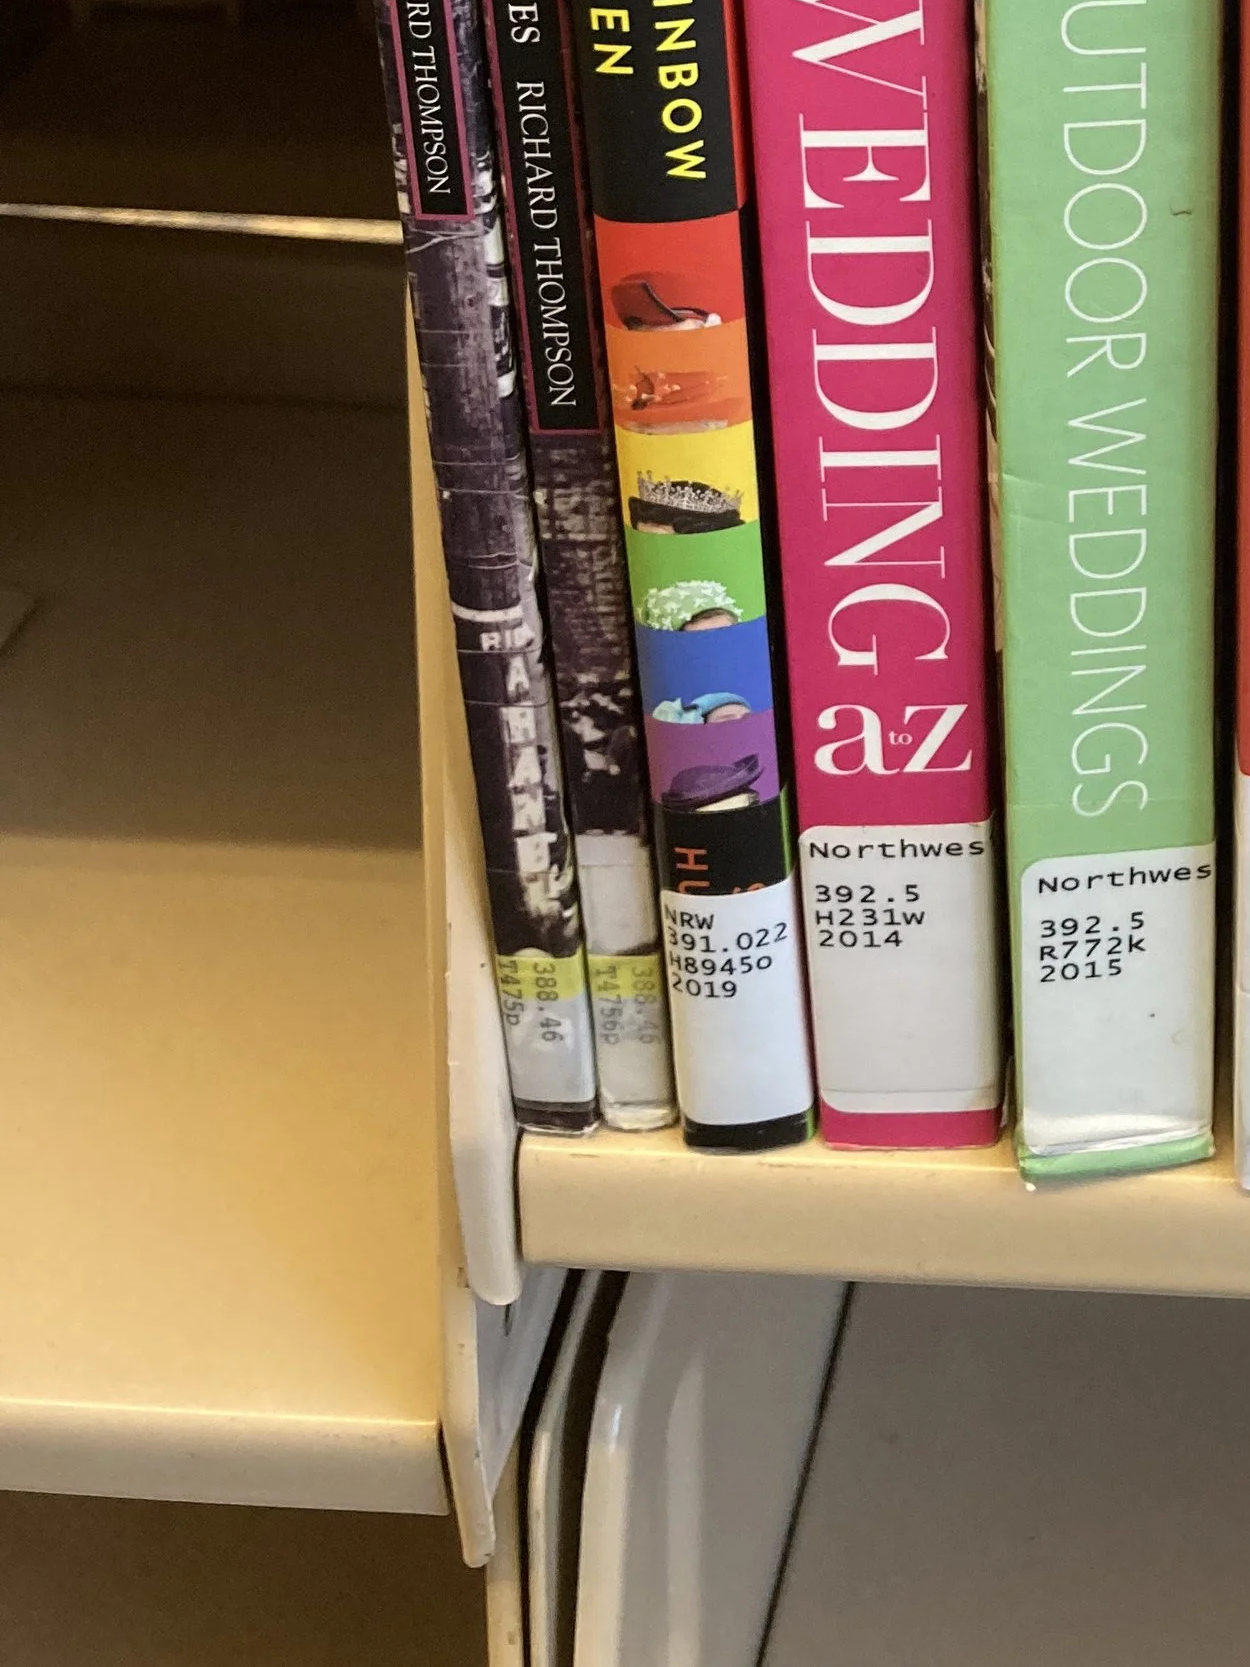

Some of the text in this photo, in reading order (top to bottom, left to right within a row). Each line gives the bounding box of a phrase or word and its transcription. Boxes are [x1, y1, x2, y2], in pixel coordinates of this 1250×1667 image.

[411, 45, 451, 195] THOMPSON
[516, 80, 576, 407] RICHARD THOMPSON
[1067, 397, 1149, 818] WEDDINGS
[813, 703, 899, 776] a
[889, 728, 913, 746] to
[808, 838, 986, 860] Northwes
[1038, 863, 1213, 895] Northwes
[815, 884, 921, 904] 392.5
[664, 903, 715, 930] NRW
[815, 908, 926, 928] H231w
[1039, 911, 1146, 939] 392.5
[667, 922, 788, 953] 391.022
[818, 929, 904, 948] 2014
[1039, 935, 1147, 962] R772k
[1039, 958, 1122, 984] 2015
[671, 972, 738, 998] 2019
[533, 961, 563, 1043] 388.46
